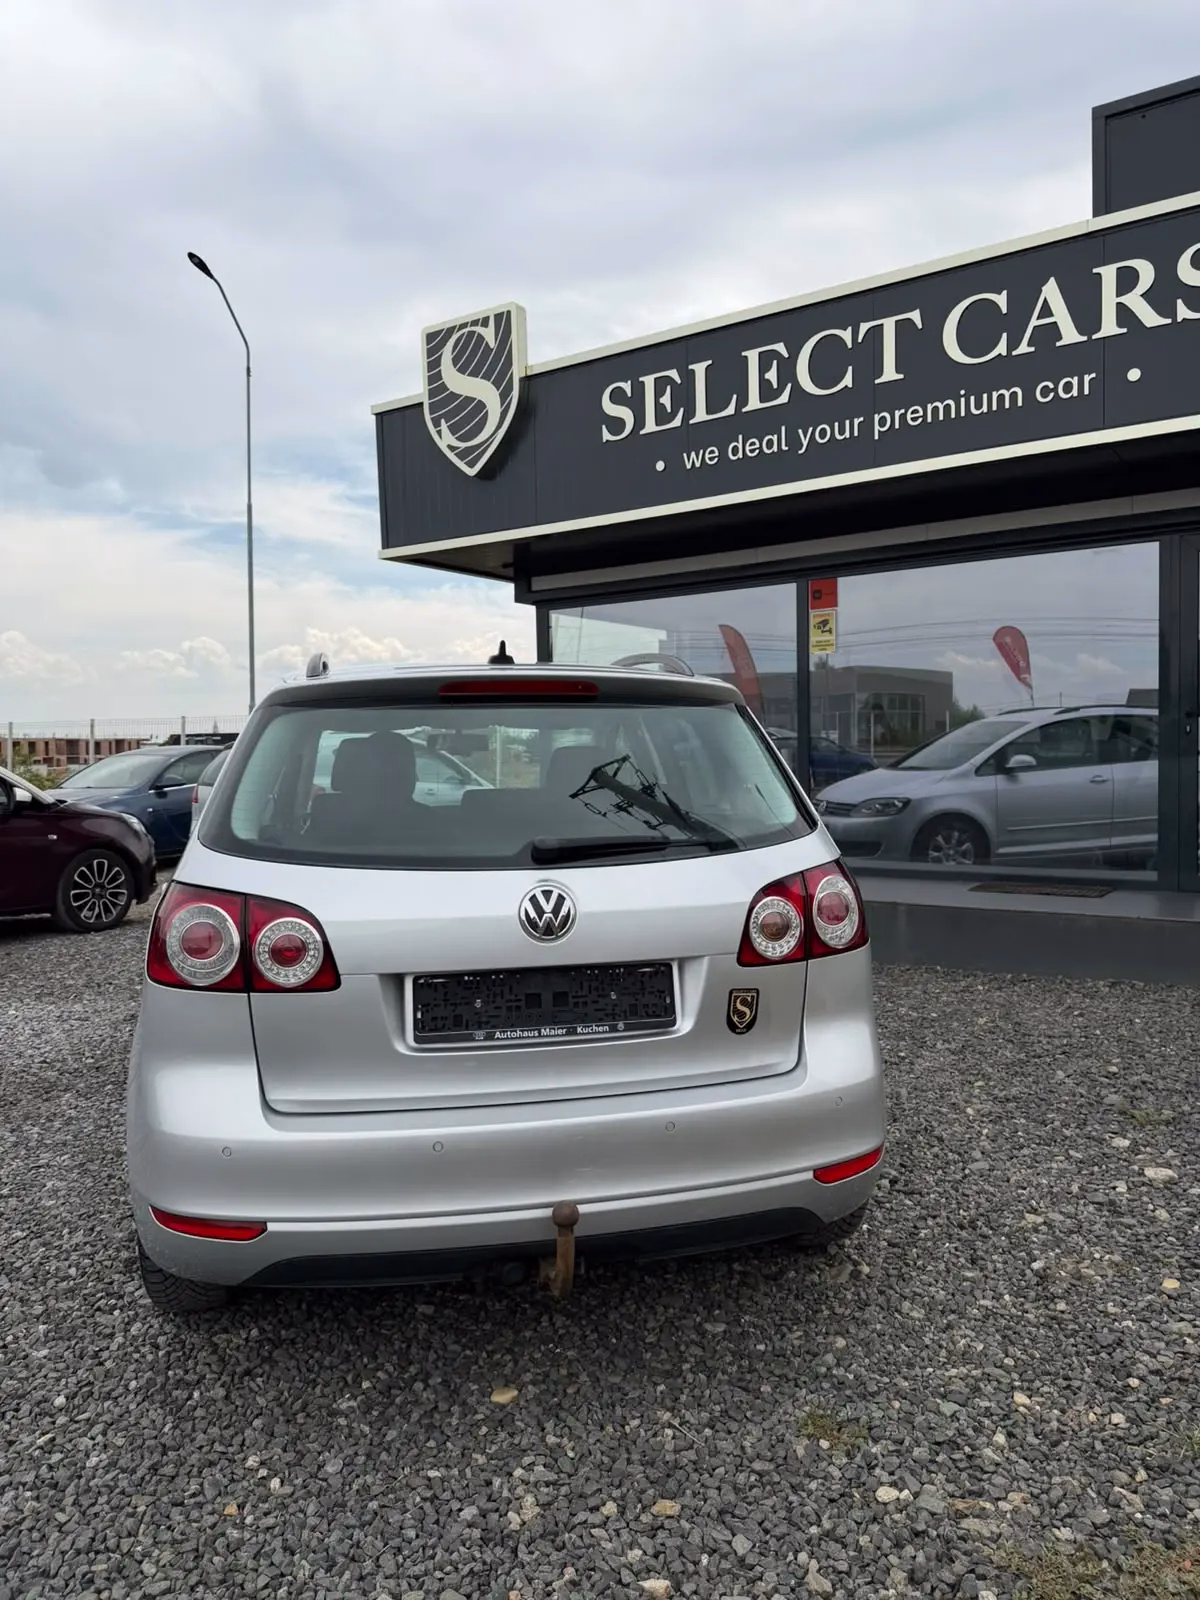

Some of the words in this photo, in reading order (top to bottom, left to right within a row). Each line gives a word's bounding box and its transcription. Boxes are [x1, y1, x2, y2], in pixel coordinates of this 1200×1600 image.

[440, 314, 501, 447] S
[602, 309, 922, 443] SELECT
[683, 447, 718, 469] we
[728, 426, 788, 460] deal
[798, 416, 864, 454] your
[874, 387, 1023, 440] premium
[1035, 373, 1097, 403] car
[520, 884, 575, 941] VW
[494, 1029, 539, 1040] Autohaus
[541, 1027, 567, 1037] Maier
[577, 1024, 609, 1034] Kuchen
